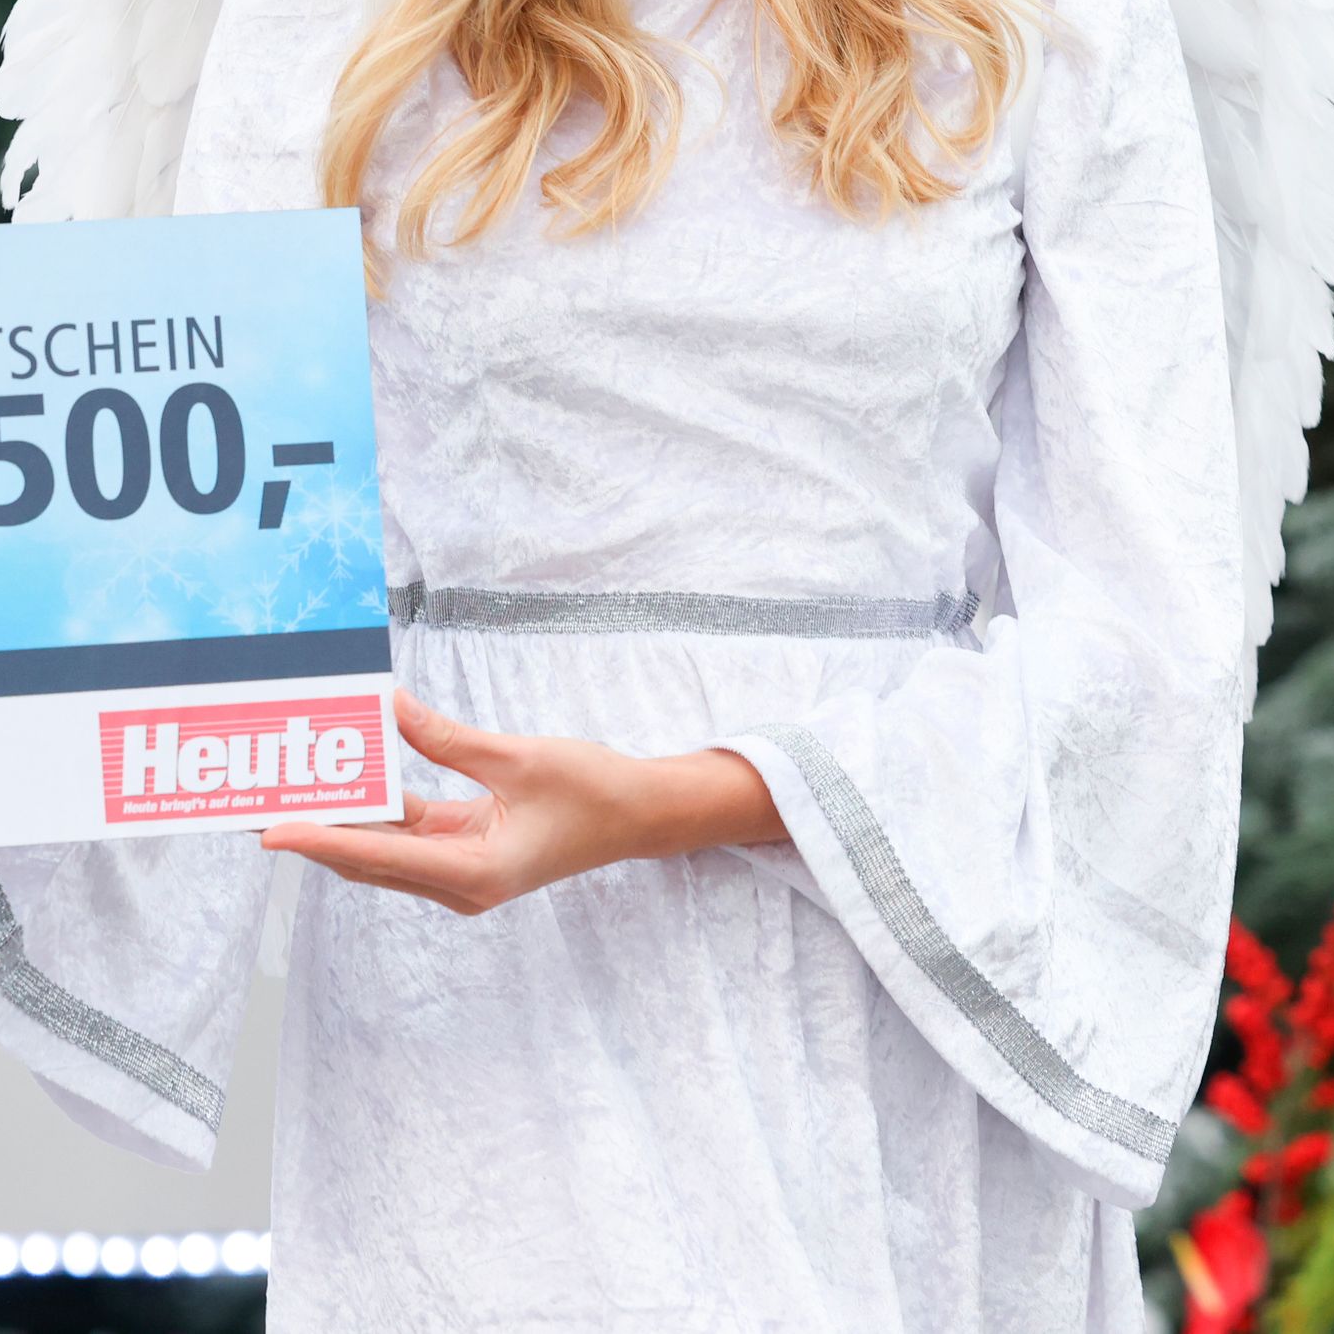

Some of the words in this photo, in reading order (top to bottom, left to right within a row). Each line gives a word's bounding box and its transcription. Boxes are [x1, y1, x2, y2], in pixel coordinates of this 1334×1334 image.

[121, 716, 366, 797] Heute
[123, 799, 157, 815] Heute
[208, 795, 231, 809] auf
[280, 786, 366, 805] www.heute.at
